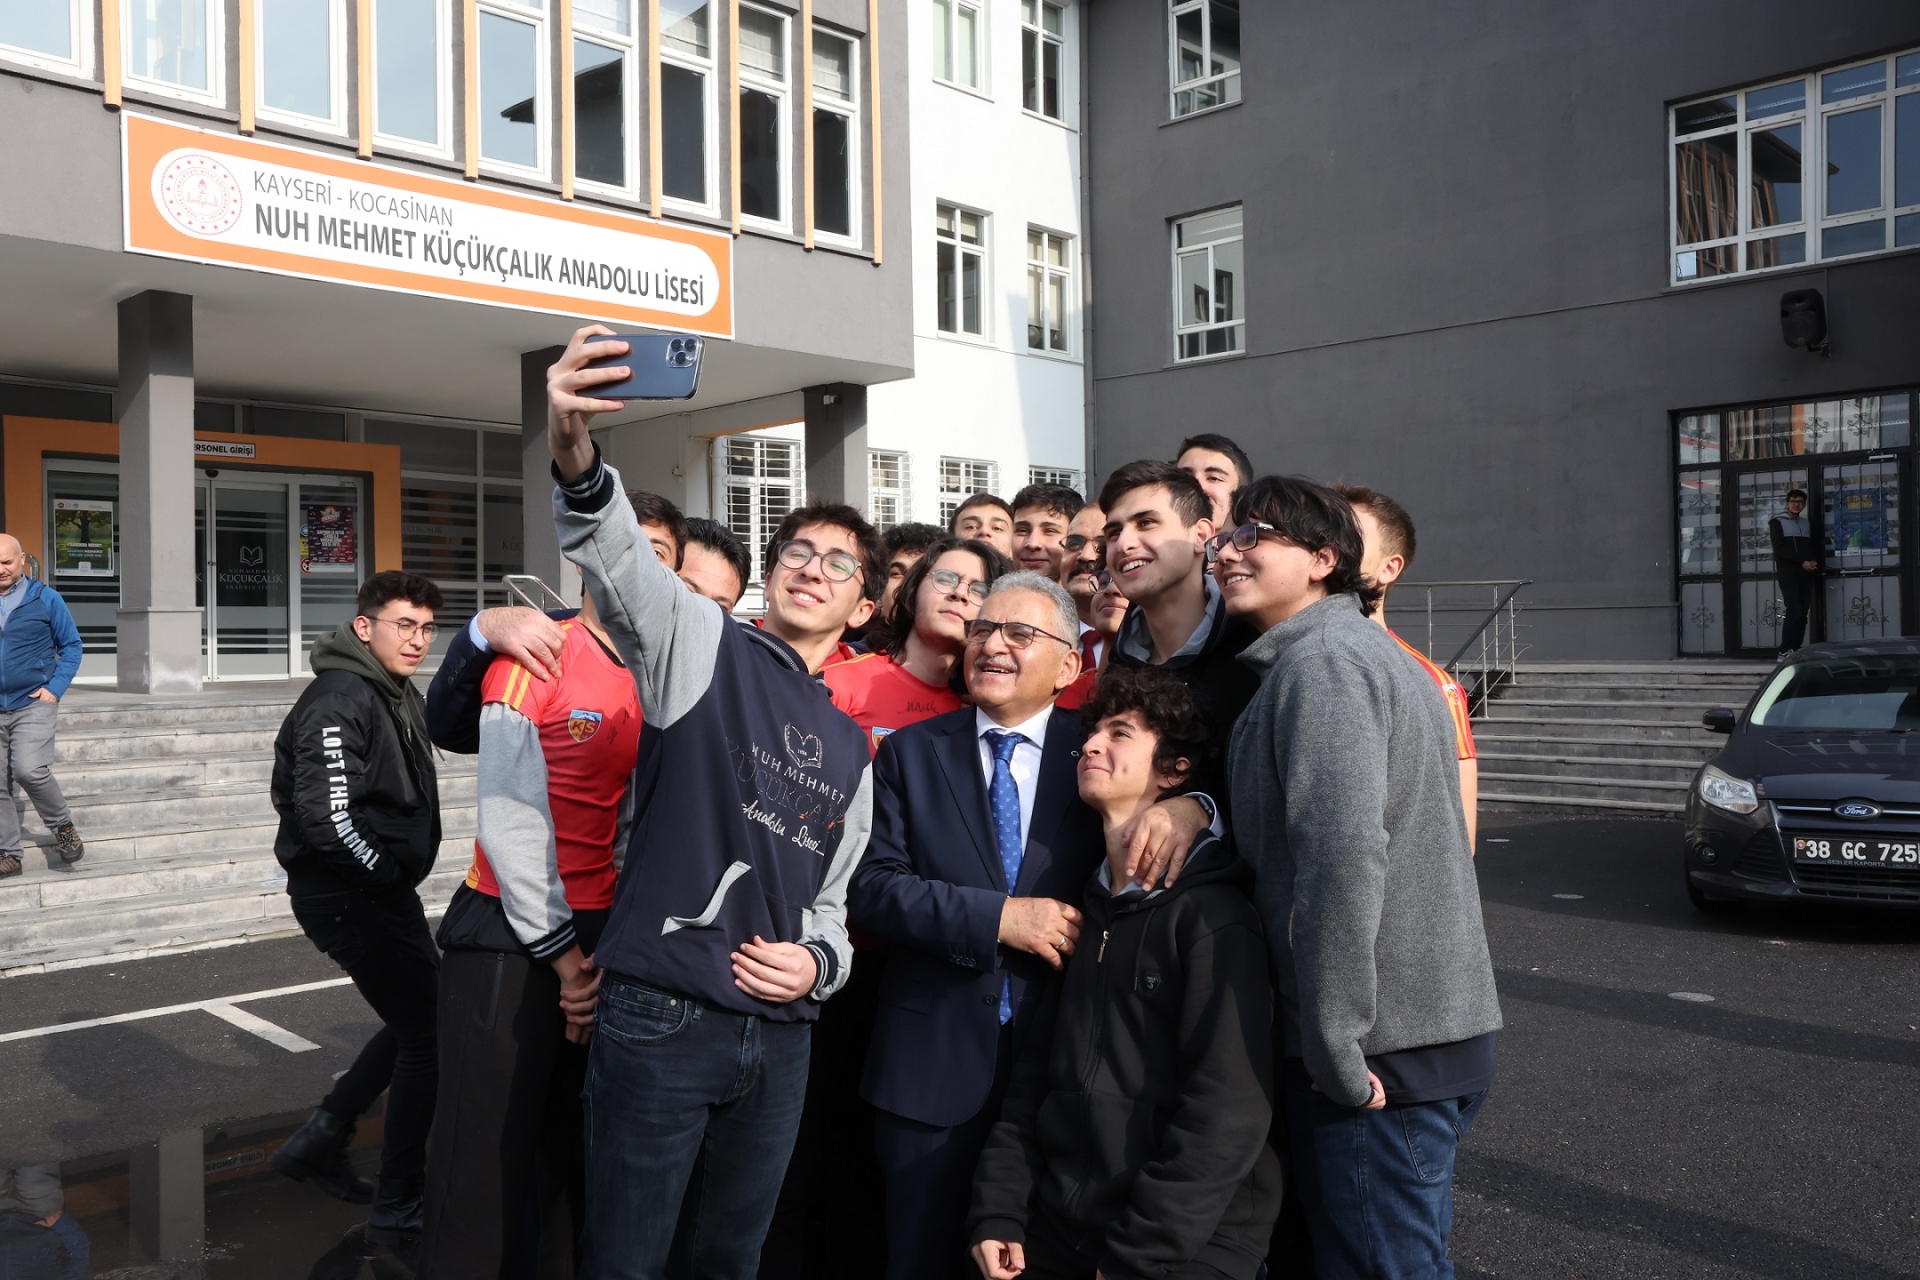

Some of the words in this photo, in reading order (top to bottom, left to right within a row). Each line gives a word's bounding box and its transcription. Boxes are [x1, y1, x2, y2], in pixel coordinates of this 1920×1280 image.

[254, 170, 331, 205] KAYSERİ
[349, 189, 453, 227] KOCASİNAN
[255, 203, 309, 243] NUH
[318, 214, 417, 259] MEHMET
[423, 230, 553, 282] KÜÇÜKÇALIK
[559, 257, 649, 297] ANADOLU
[655, 268, 704, 306] LİSESİ
[229, 444, 253, 457] GİRİŞİ
[322, 726, 346, 769] LOFT
[329, 774, 349, 811] THE
[784, 765, 845, 805] MEHMET
[1844, 805, 1868, 815] Ford
[1806, 840, 1831, 859] 38
[1841, 842, 1867, 860] GC
[1877, 843, 1918, 863] 725
[1853, 860, 1886, 868] KAPORTA
